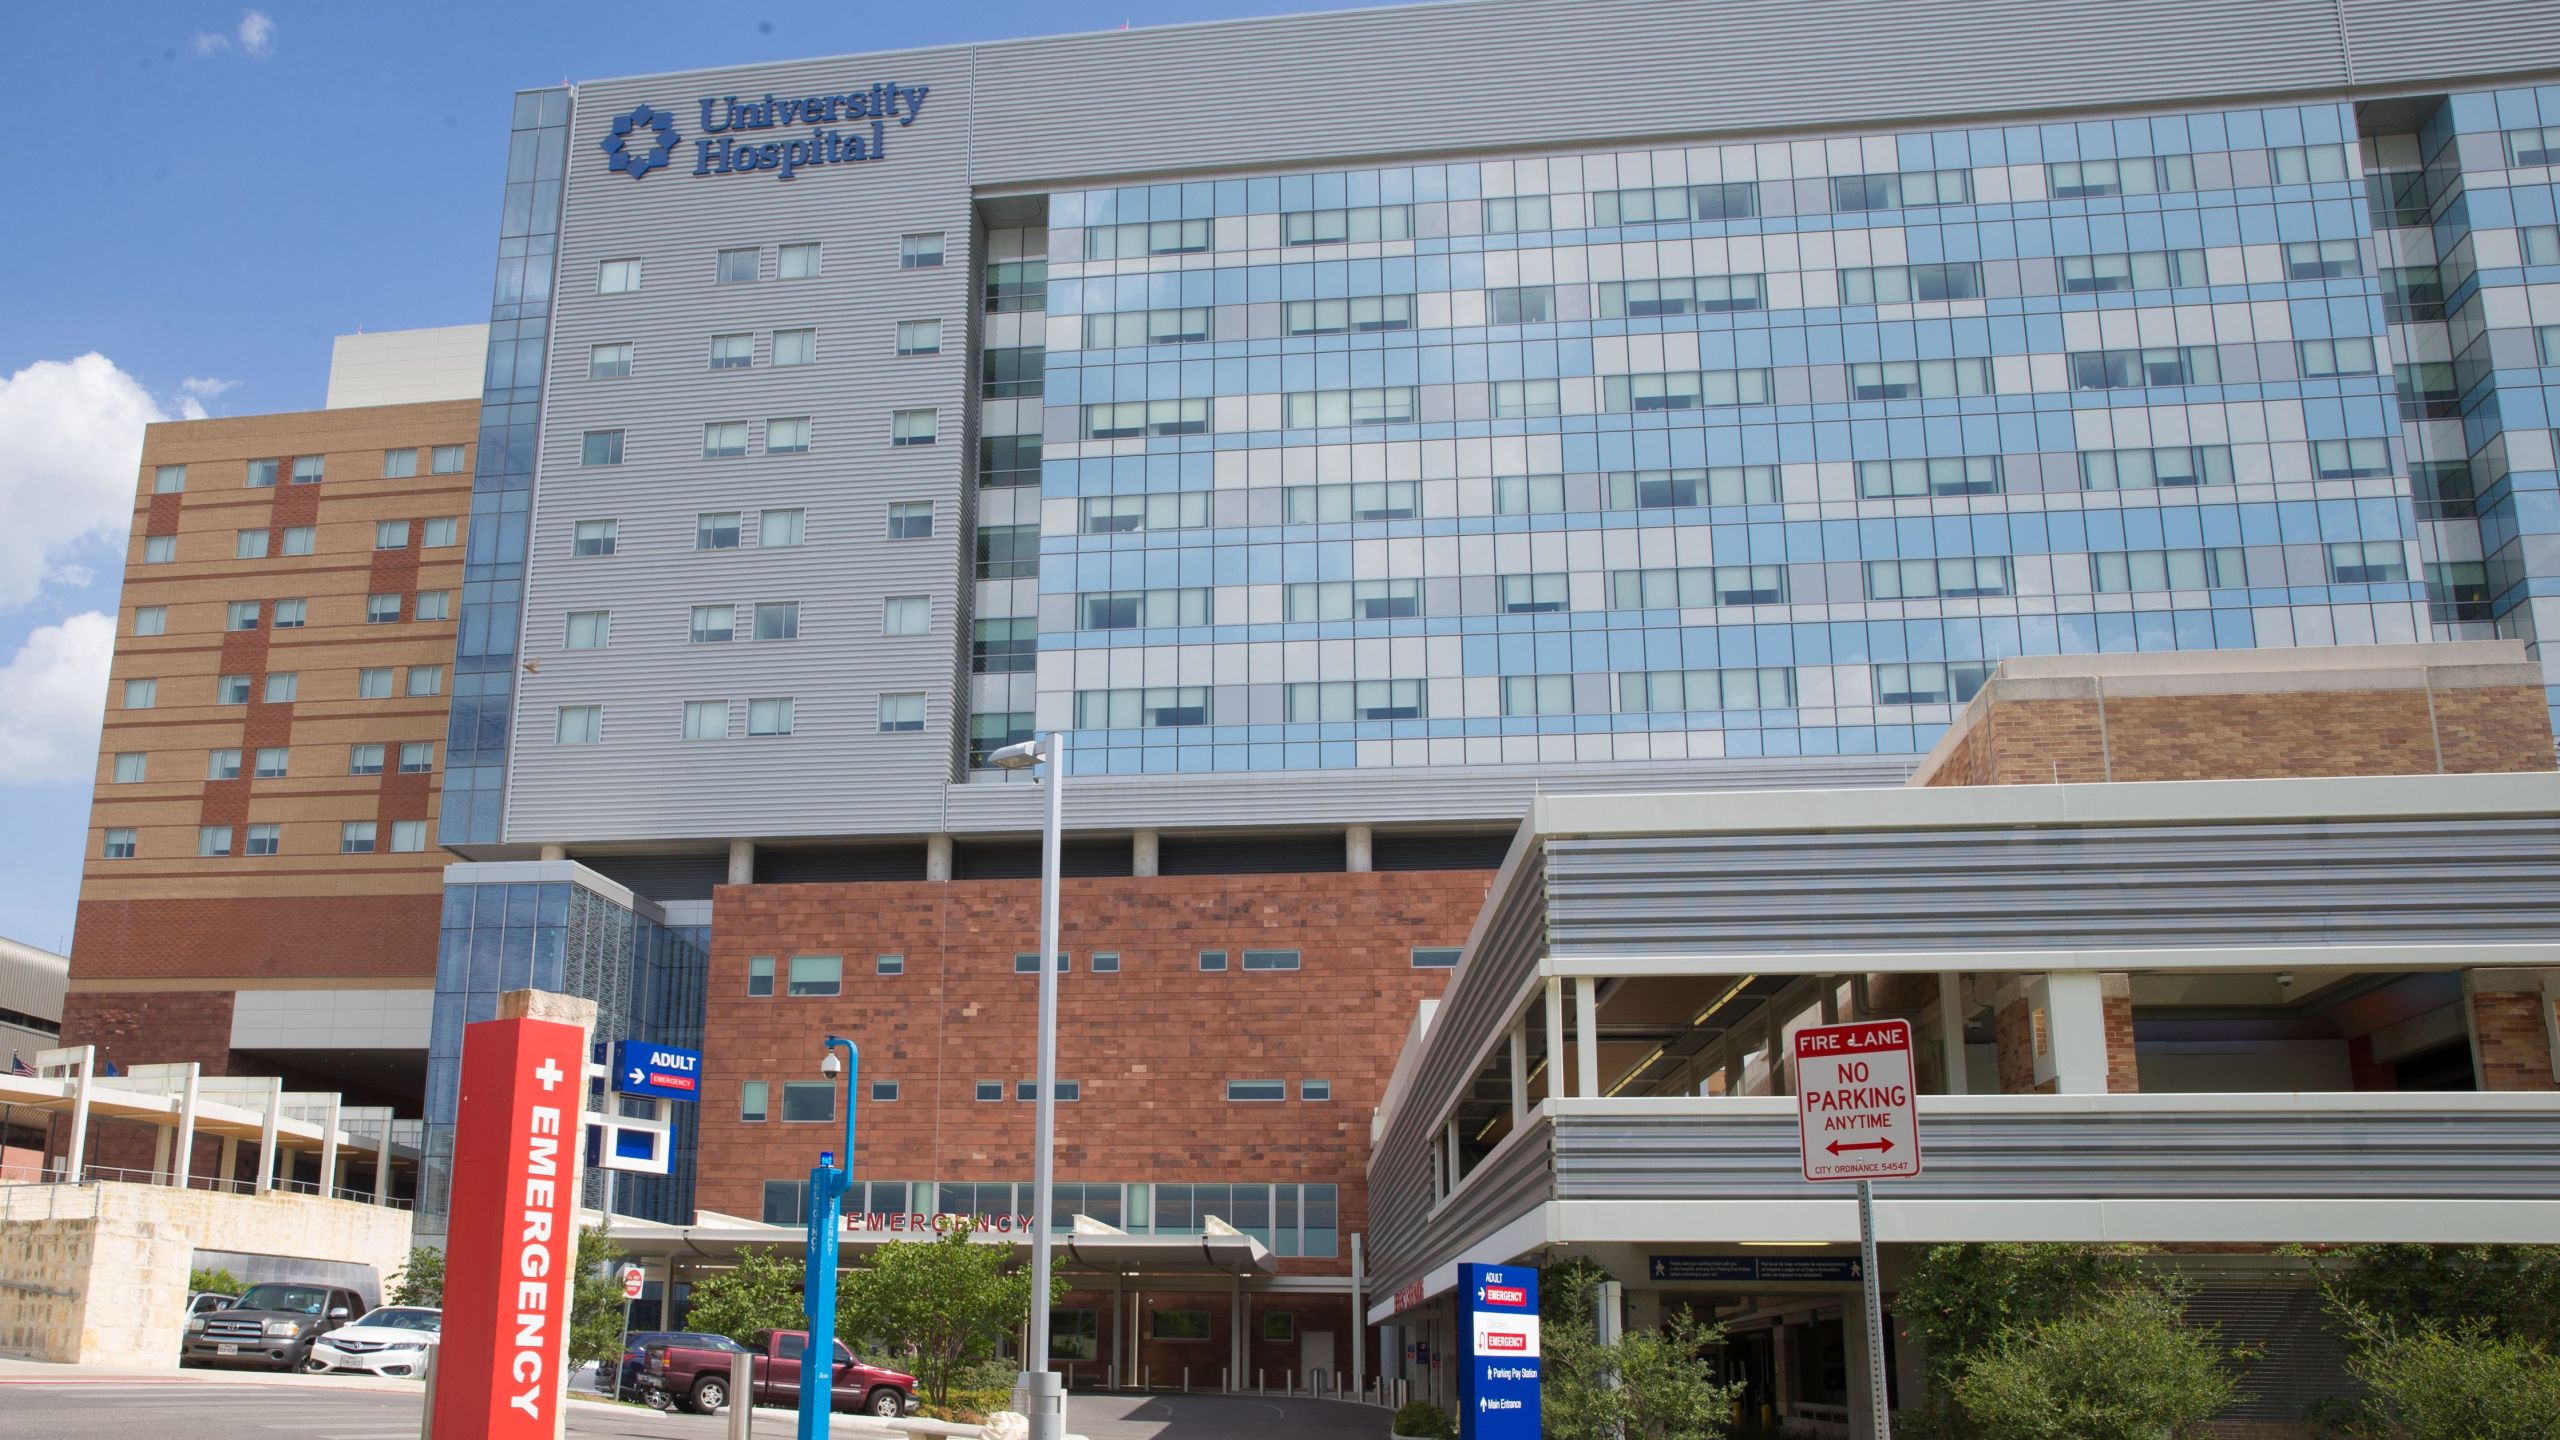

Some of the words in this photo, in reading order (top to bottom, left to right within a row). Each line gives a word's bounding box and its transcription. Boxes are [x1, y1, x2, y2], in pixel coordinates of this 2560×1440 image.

[698, 83, 930, 132] University
[692, 122, 885, 180] Hospital
[1800, 1034, 1840, 1052] FIRE
[1851, 1029, 1904, 1048] LANE
[650, 1051, 697, 1071] ADULT
[653, 1074, 692, 1087] EMERGENCY
[1837, 1061, 1870, 1084] NO
[1806, 1085, 1906, 1113] PARKING
[1824, 1112, 1893, 1131] ANYTIME
[1814, 1166, 1832, 1175] CITY
[1834, 1163, 1879, 1174] ORDINANCE
[1881, 1162, 1908, 1171] 54547
[510, 1105, 560, 1421] EMERGENCY
[1485, 1271, 1503, 1284] ADULT
[1487, 1289, 1523, 1303] EMERGENCY
[1488, 1336, 1524, 1348] EMERGENCY
[1493, 1367, 1511, 1380] Parking
[1511, 1367, 1521, 1380] Pay
[1521, 1367, 1538, 1379] Station
[1487, 1399, 1500, 1410] Main
[1500, 1398, 1522, 1409] Entrance
